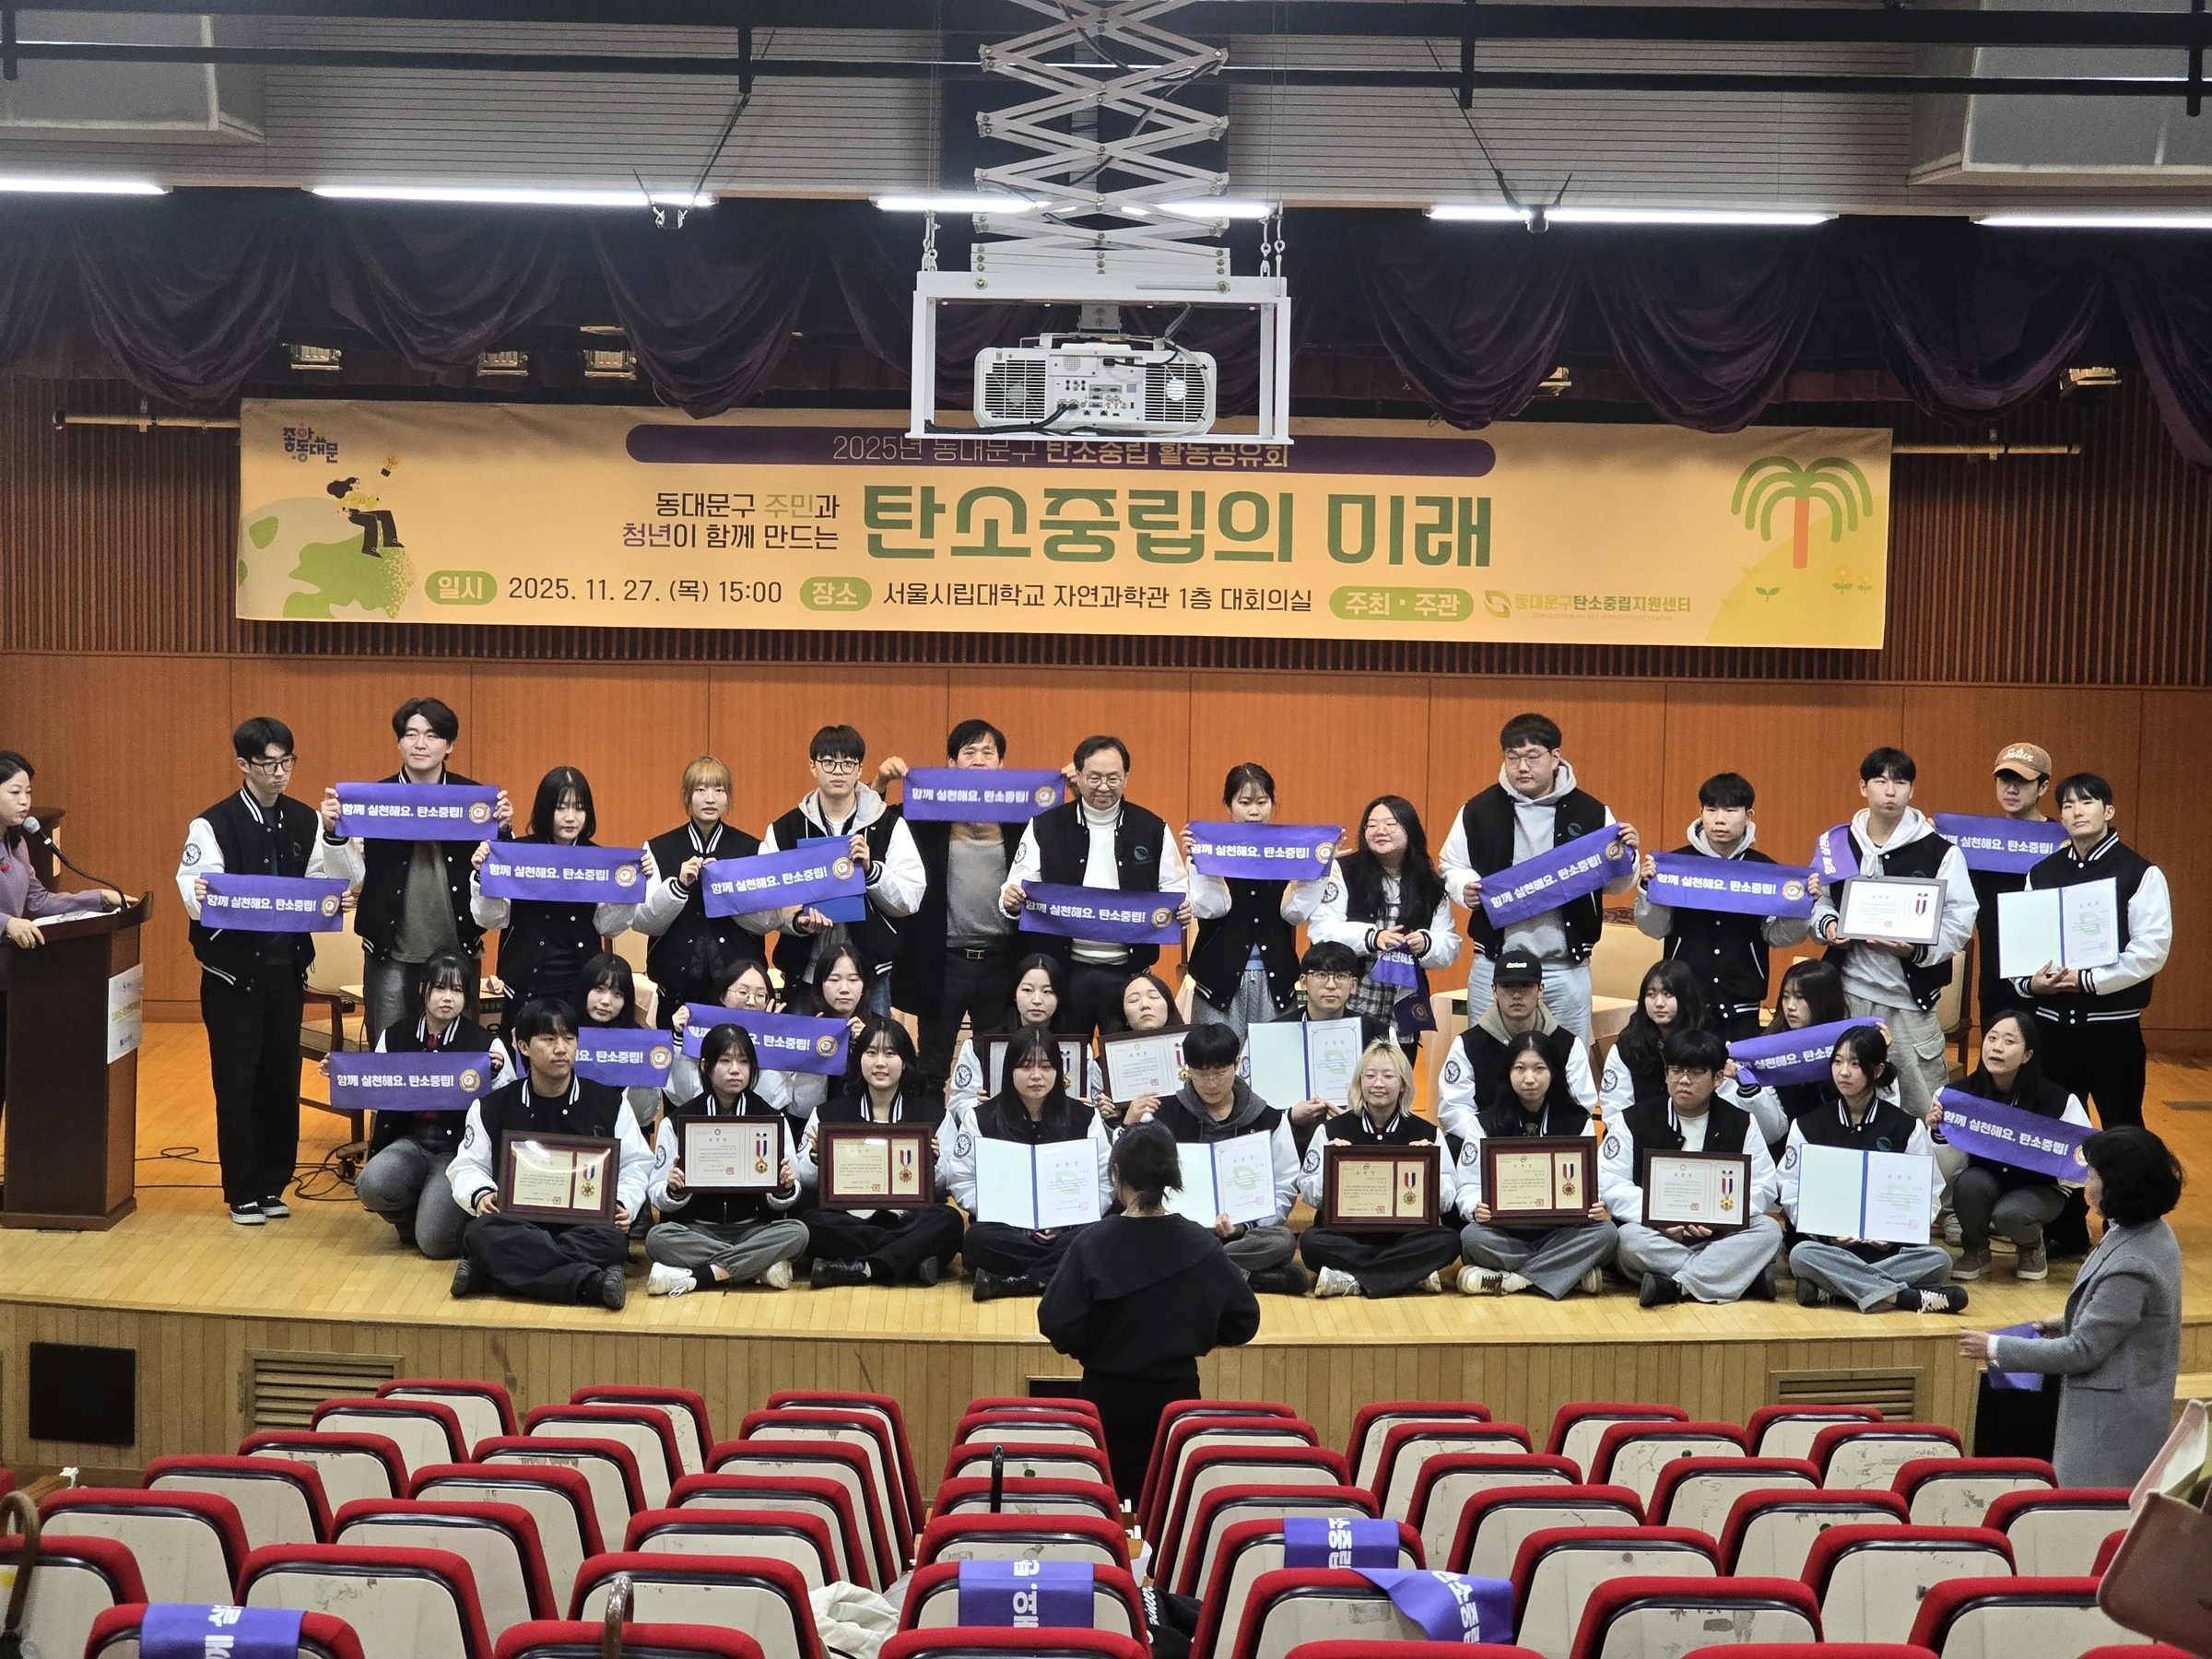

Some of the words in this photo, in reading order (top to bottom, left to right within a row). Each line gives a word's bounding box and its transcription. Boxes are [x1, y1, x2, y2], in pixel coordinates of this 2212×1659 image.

[833, 435, 923, 461] 2025년
[656, 493, 755, 518] 동대문구
[763, 494, 841, 519] 주민과
[623, 524, 695, 547] 청년이
[706, 524, 754, 548] 함께
[765, 525, 838, 549] 만드는
[865, 485, 1292, 563] 탄소중립의
[1328, 494, 1491, 567] 미래
[437, 575, 483, 600] 일시
[510, 578, 575, 599] 2025.
[587, 580, 614, 600] 11.
[624, 580, 659, 601] 27.
[670, 581, 708, 602] (목)
[719, 582, 781, 603] 15:00
[812, 582, 858, 606] 장소
[884, 582, 1044, 606] 서울시립대학교
[1053, 585, 1170, 608] 자연과학관
[1180, 588, 1212, 609] 1층
[1221, 588, 1311, 611] 대회의실
[1345, 592, 1390, 616] 주최
[1414, 593, 1460, 617] 주관
[1514, 593, 1692, 613] 동대문구탄소중립지원센터
[912, 788, 934, 800] 함께
[936, 790, 981, 802] 실천해요.
[984, 791, 1029, 803] 탄소중립!
[342, 804, 365, 815] 함께
[368, 805, 414, 817] 실천해요.
[418, 806, 463, 818] 탄소중립!
[1216, 845, 1260, 857] 실천해요.
[1264, 847, 1309, 858] 탄소중립!
[1959, 837, 2004, 852] 실천해요.
[2008, 841, 2053, 854] 탄소중립!
[489, 864, 511, 876] 함께
[514, 866, 559, 878] 실천해요.
[563, 868, 608, 881] 탄소중립!
[712, 882, 734, 894] 함께
[735, 876, 780, 891] 실천해요.
[782, 866, 827, 884] 탄소중립!
[1490, 891, 1513, 908] 함께
[1514, 872, 1559, 899] 실천해요.
[1558, 853, 1602, 880] 탄소중립!
[1657, 874, 1678, 885] 함께
[1681, 877, 1726, 890] 실천해요.
[1730, 881, 1776, 894] 탄소중립!
[206, 894, 229, 907] 함께
[231, 897, 272, 909] 실천해요.
[276, 899, 316, 912] 탄소중립!
[1027, 900, 1047, 913] 함께
[1050, 905, 1095, 918] 실천해요.
[1100, 910, 1146, 923] 탄소중립!
[764, 1035, 810, 1050] 탄소중립!
[596, 1052, 643, 1063] 탄소중립!
[1755, 1053, 1801, 1068] 실천해요.
[337, 1075, 359, 1086] 함께
[361, 1076, 406, 1087] 실천해요.
[409, 1076, 453, 1087] 탄소중립!
[1944, 1111, 1967, 1127] 함께
[1970, 1119, 2016, 1141] 실천해요.
[2019, 1133, 2068, 1155] 탄소중립!
